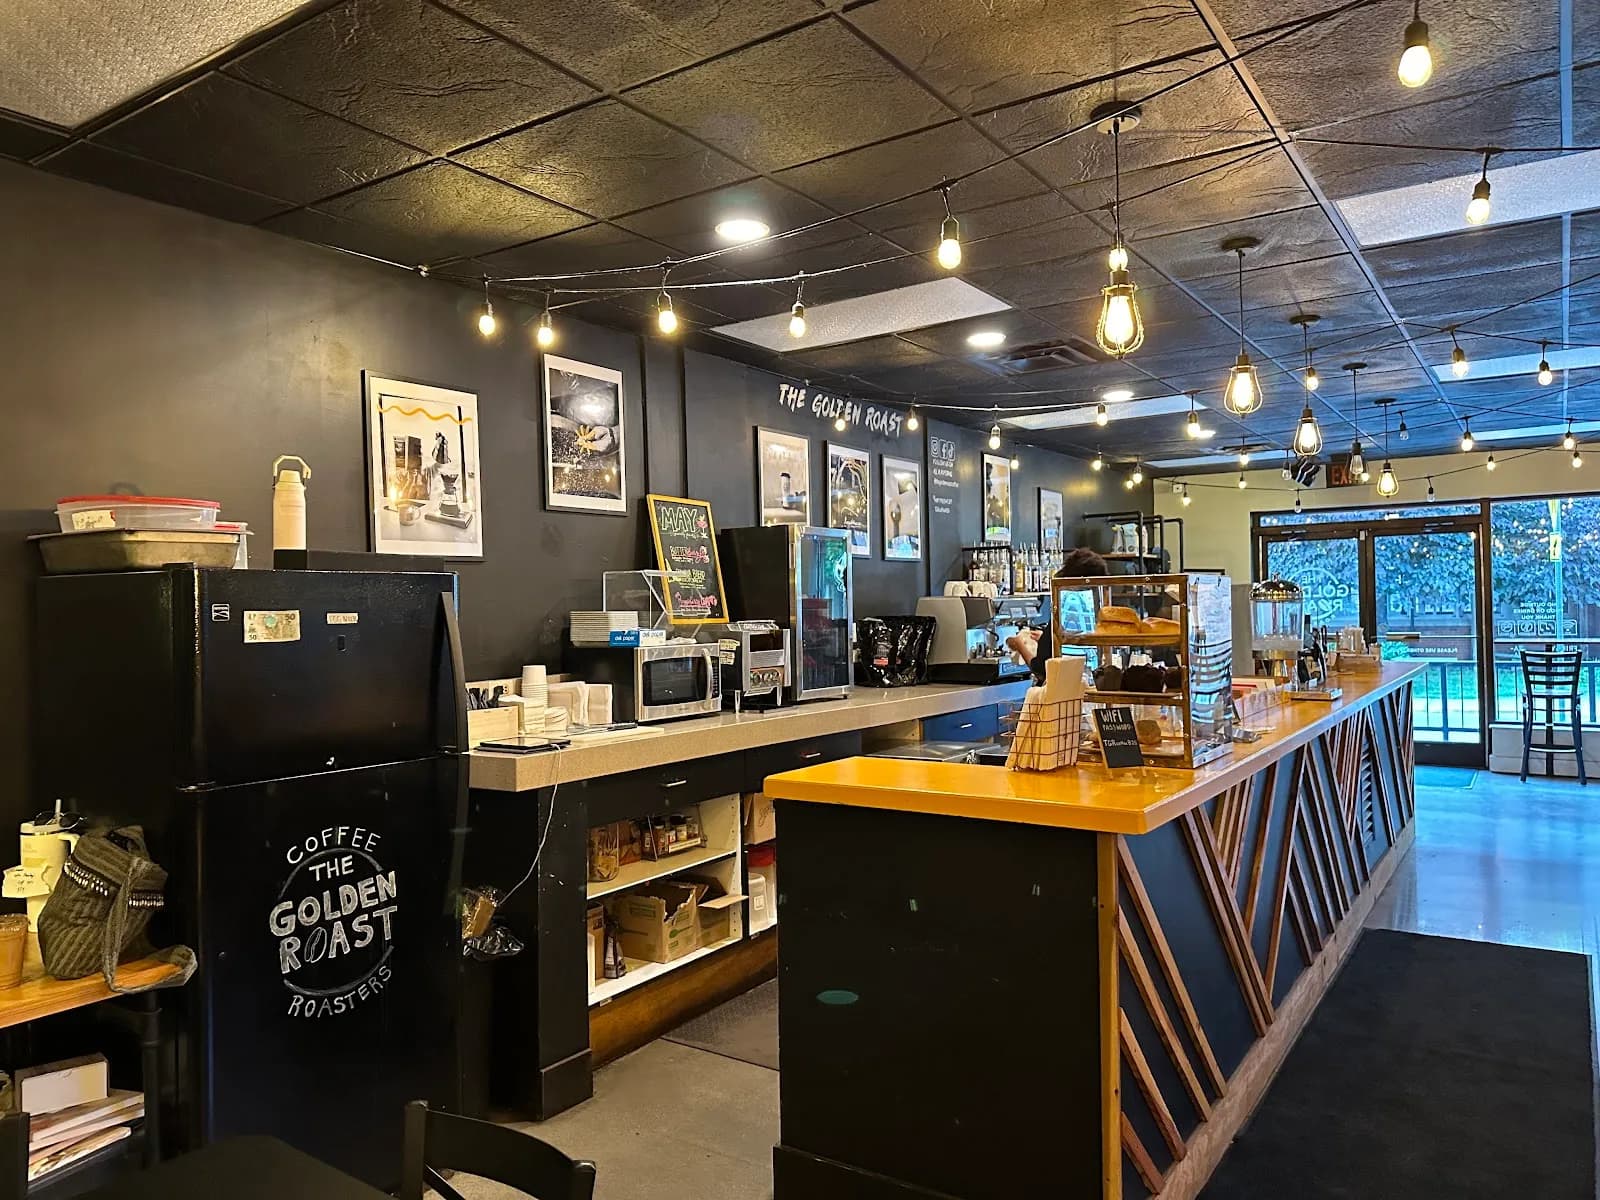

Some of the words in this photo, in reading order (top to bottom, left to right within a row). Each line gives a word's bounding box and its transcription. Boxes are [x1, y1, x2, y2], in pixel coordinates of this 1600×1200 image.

[779, 383, 806, 412] THE
[812, 393, 862, 425] GOLDEN
[865, 406, 903, 437] ROAST
[661, 506, 697, 532] MAY
[286, 826, 381, 864] COFFEE
[309, 855, 355, 882] THE
[269, 871, 398, 937] GOLDEN
[279, 905, 398, 974] ROAST
[288, 965, 393, 1019] ROASTERS
